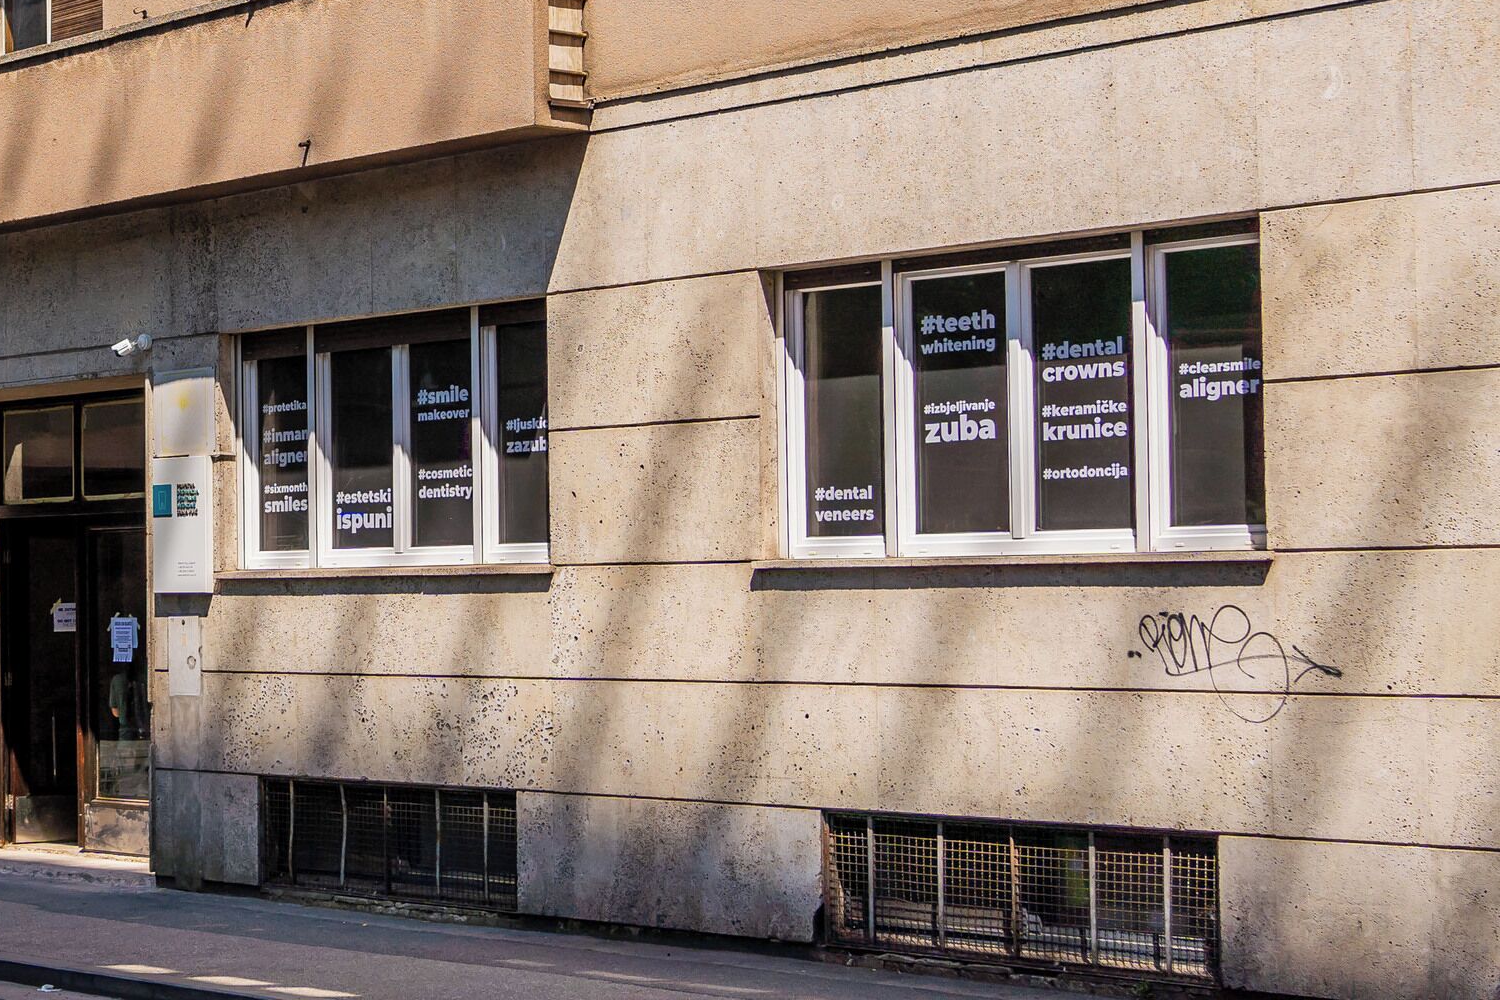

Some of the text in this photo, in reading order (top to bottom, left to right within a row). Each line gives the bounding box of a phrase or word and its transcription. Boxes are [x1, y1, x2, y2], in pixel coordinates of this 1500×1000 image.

[920, 309, 996, 335] #teeth
[920, 335, 996, 355] whitening
[1041, 336, 1124, 361] #dental
[1042, 360, 1125, 382] crowns
[1178, 357, 1262, 376] #clearsmile
[417, 384, 469, 405] #smile
[1179, 376, 1260, 401] aligner
[262, 400, 307, 415] #protetika
[417, 408, 470, 422] makeover
[923, 398, 996, 415] #izbjeljivanje
[1041, 399, 1128, 417] #keramičke
[924, 414, 996, 444] zuba
[1042, 417, 1128, 441] krunice
[418, 464, 474, 480] #cosmetic
[1042, 463, 1128, 480] #ortodoncija
[264, 482, 308, 494] #sixmonth
[336, 488, 392, 504] #estetski
[418, 483, 473, 500] dentistry
[814, 485, 873, 501] #dental
[264, 495, 309, 513] smiles
[336, 506, 393, 534] ispuni
[815, 508, 875, 522] veneers
